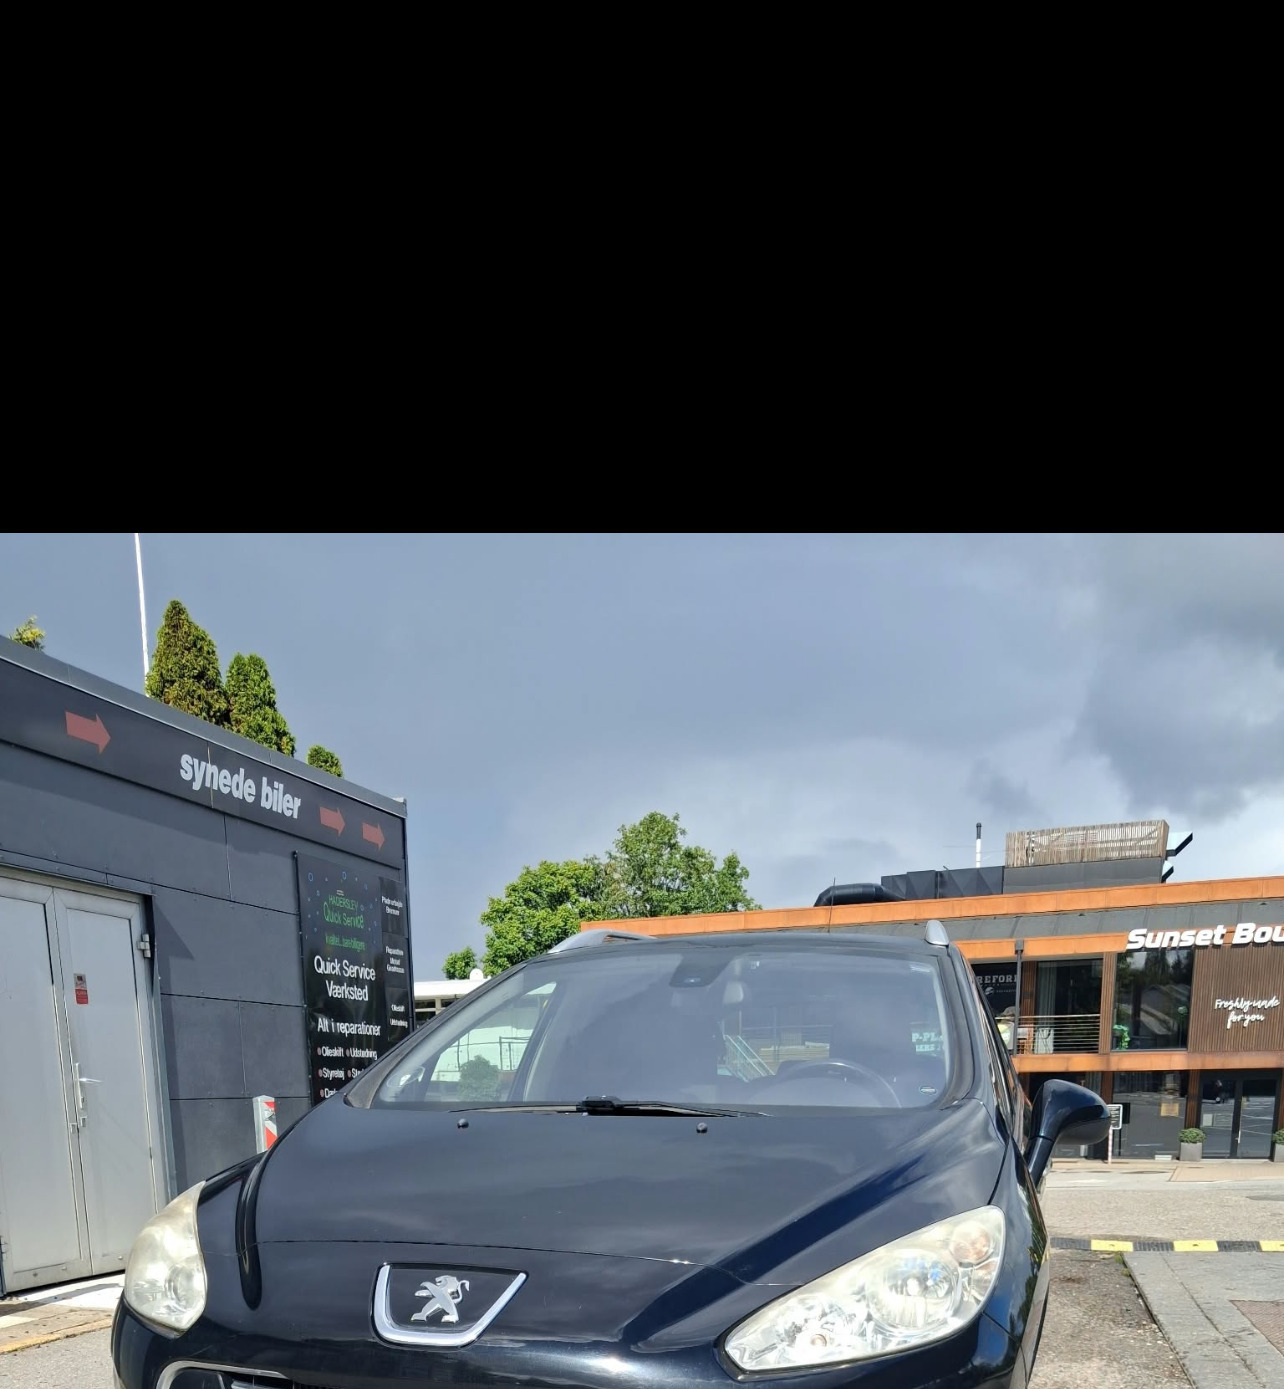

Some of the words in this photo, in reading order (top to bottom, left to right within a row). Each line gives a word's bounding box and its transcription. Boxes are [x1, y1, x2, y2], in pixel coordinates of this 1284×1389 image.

[179, 754, 256, 803] synede
[260, 776, 302, 819] biler
[1125, 924, 1228, 951] Sunset
[313, 955, 342, 976] Quick
[342, 959, 377, 981] Service
[325, 979, 369, 1002] Værksted
[1214, 996, 1251, 1013] Freshly
[317, 1017, 330, 1033] Alt
[336, 1020, 382, 1037] reparationer
[1226, 1011, 1243, 1029] for
[1243, 1013, 1265, 1028] you
